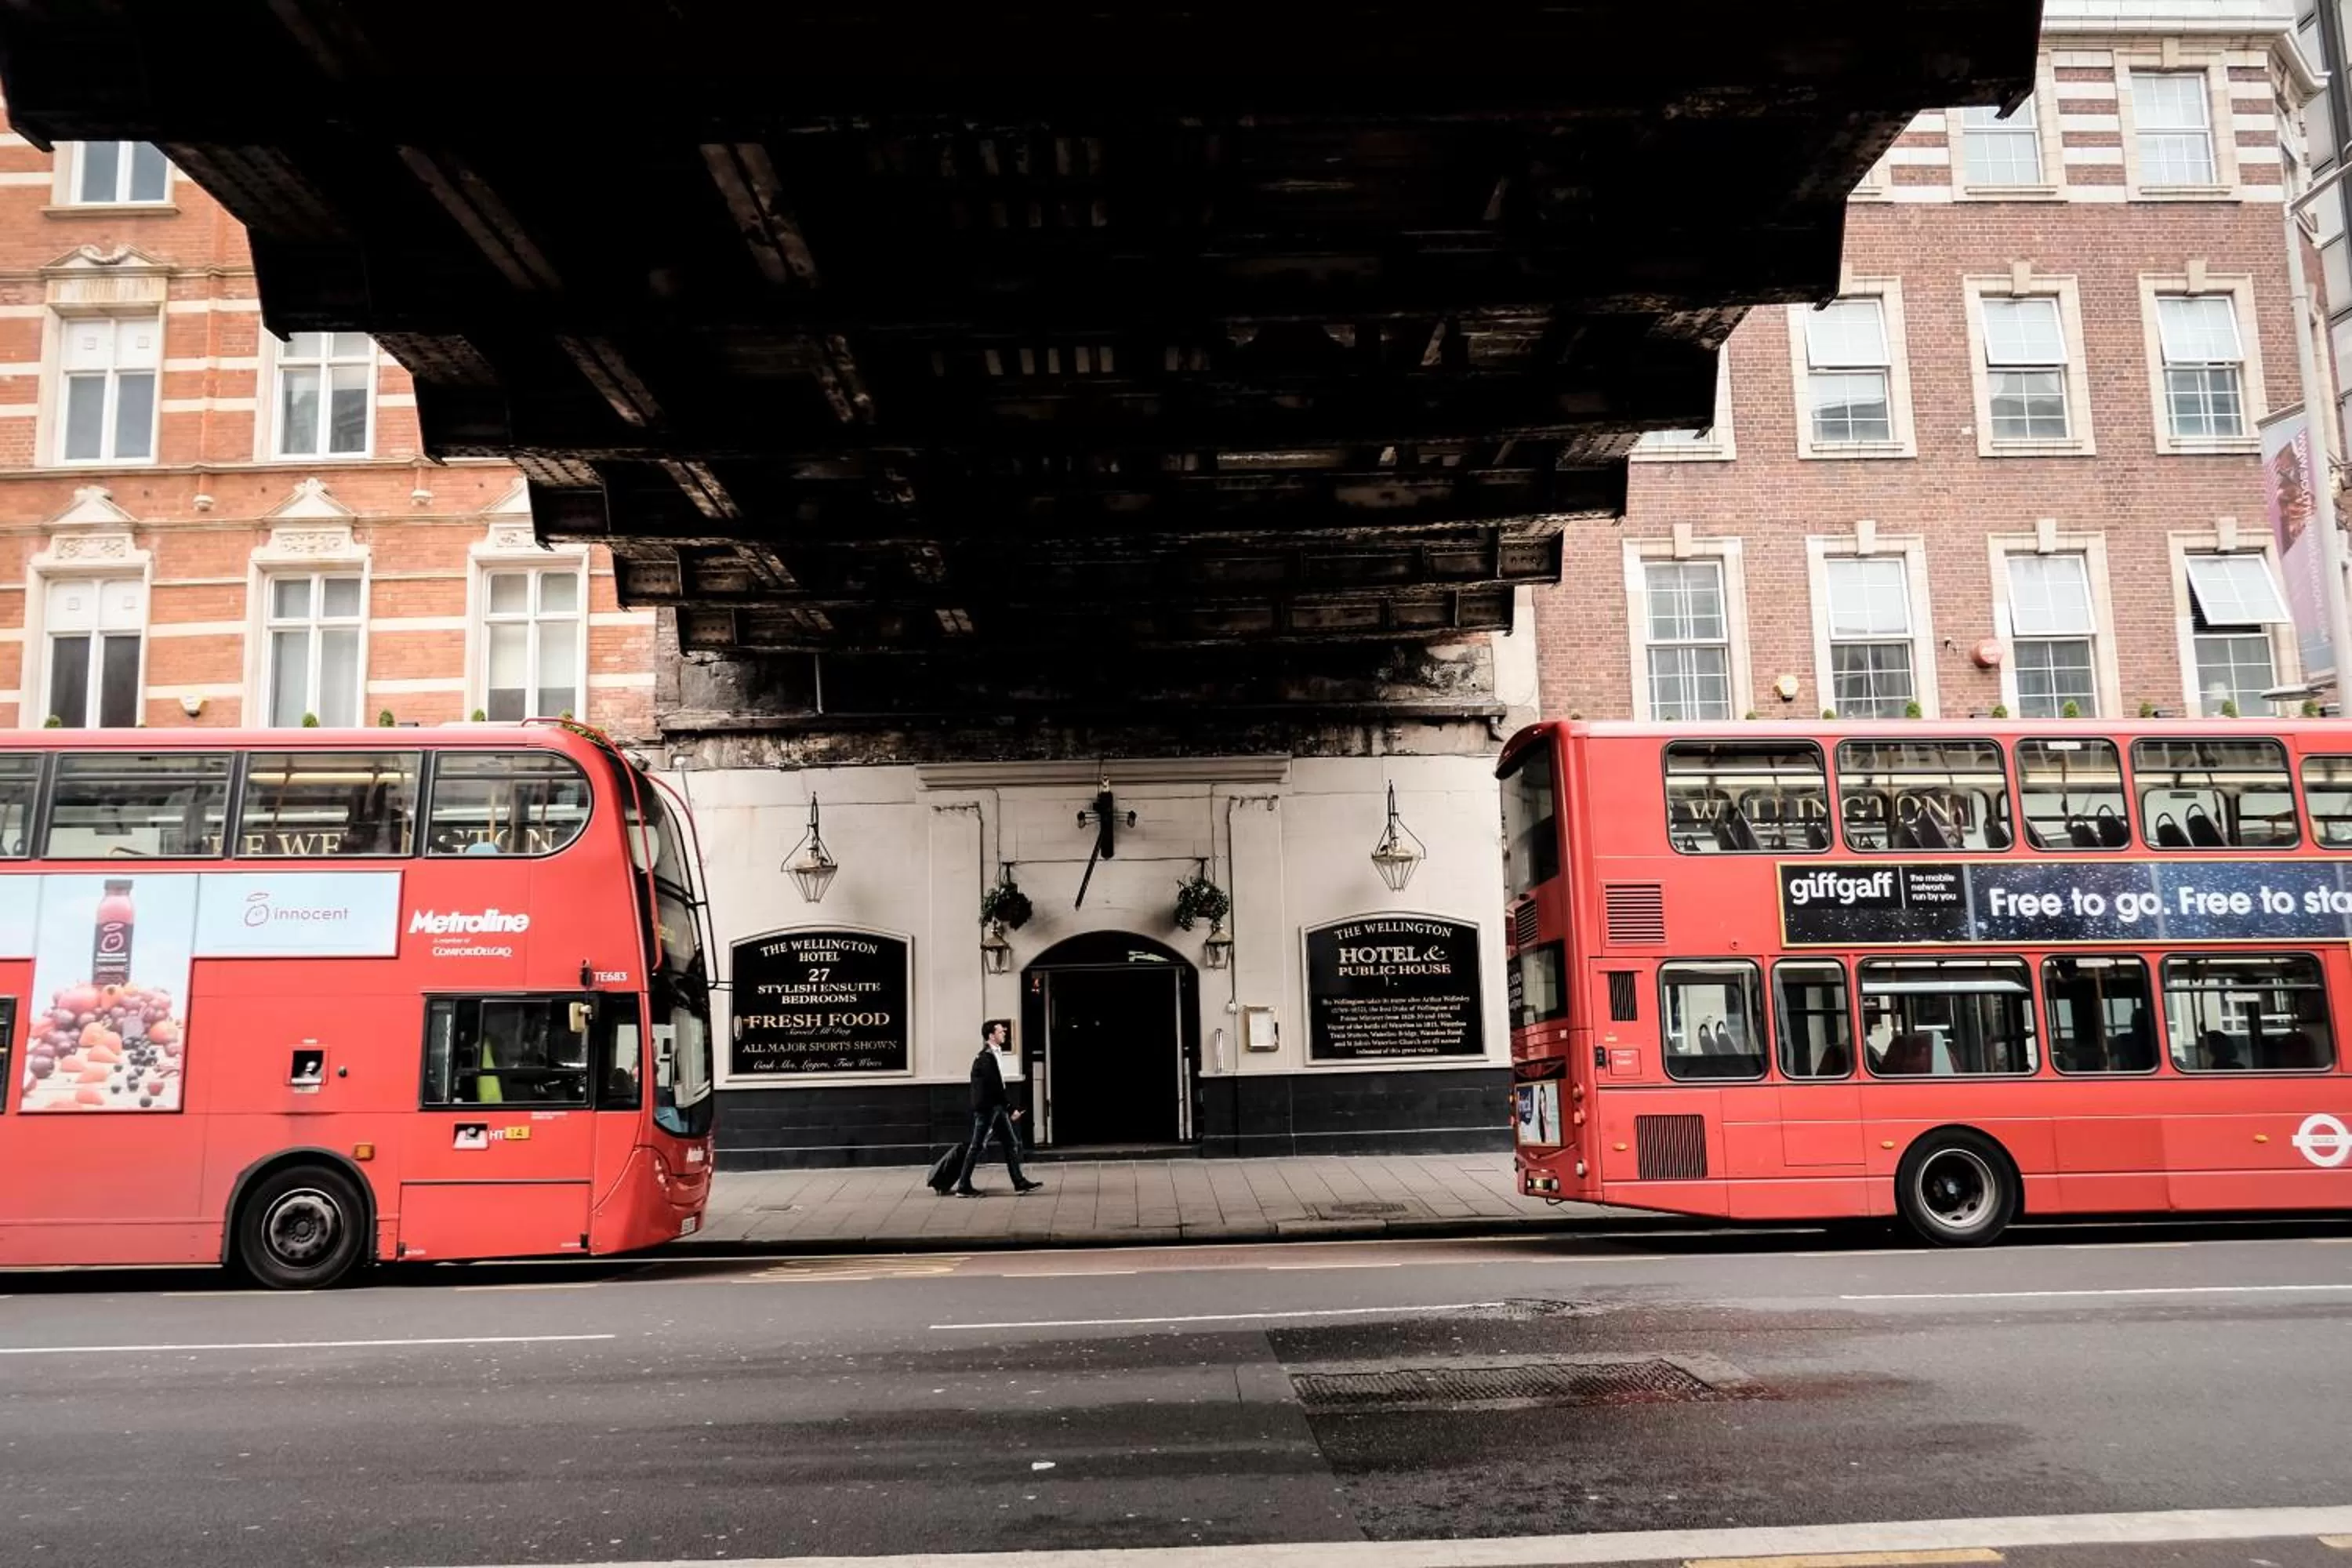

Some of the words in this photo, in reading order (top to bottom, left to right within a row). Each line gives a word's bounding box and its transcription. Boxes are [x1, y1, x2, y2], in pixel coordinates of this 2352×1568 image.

[1686, 795, 1953, 825] WLLINGTON
[1909, 873, 1924, 882] the
[1925, 873, 1956, 882] mobile
[1789, 871, 1893, 905] giffgaff
[1911, 883, 1946, 892] network
[1927, 891, 1939, 902] by
[1940, 892, 1957, 902] you
[1989, 887, 2062, 917] Free
[2071, 887, 2107, 917] to
[2115, 889, 2172, 923] go.
[2179, 886, 2252, 916] Free
[2260, 885, 2296, 915] to
[274, 907, 350, 920] innocent
[408, 909, 530, 934] Metroline
[1334, 924, 1363, 940] THE
[1366, 922, 1453, 938] WELLINGTON
[760, 942, 788, 957] THE
[790, 938, 878, 955] WELLINGTON
[798, 951, 841, 963] HOTEL
[1339, 946, 1421, 964] HOTEL
[1423, 945, 1448, 961] &
[808, 968, 831, 982] 27
[1338, 965, 1397, 976] PUBLIC
[1399, 964, 1452, 975] HOUSE
[757, 984, 817, 995] STYLISH
[820, 982, 881, 993] ENSUITE
[781, 993, 858, 1005] BEDROOMS
[748, 1014, 822, 1029] FRESH
[828, 1012, 891, 1027] FOOD
[742, 1044, 766, 1053] ALL
[768, 1042, 807, 1052] MAJOR
[808, 1041, 851, 1051] SPORTS
[853, 1040, 898, 1051] SHOWN
[489, 1131, 504, 1140] HT
